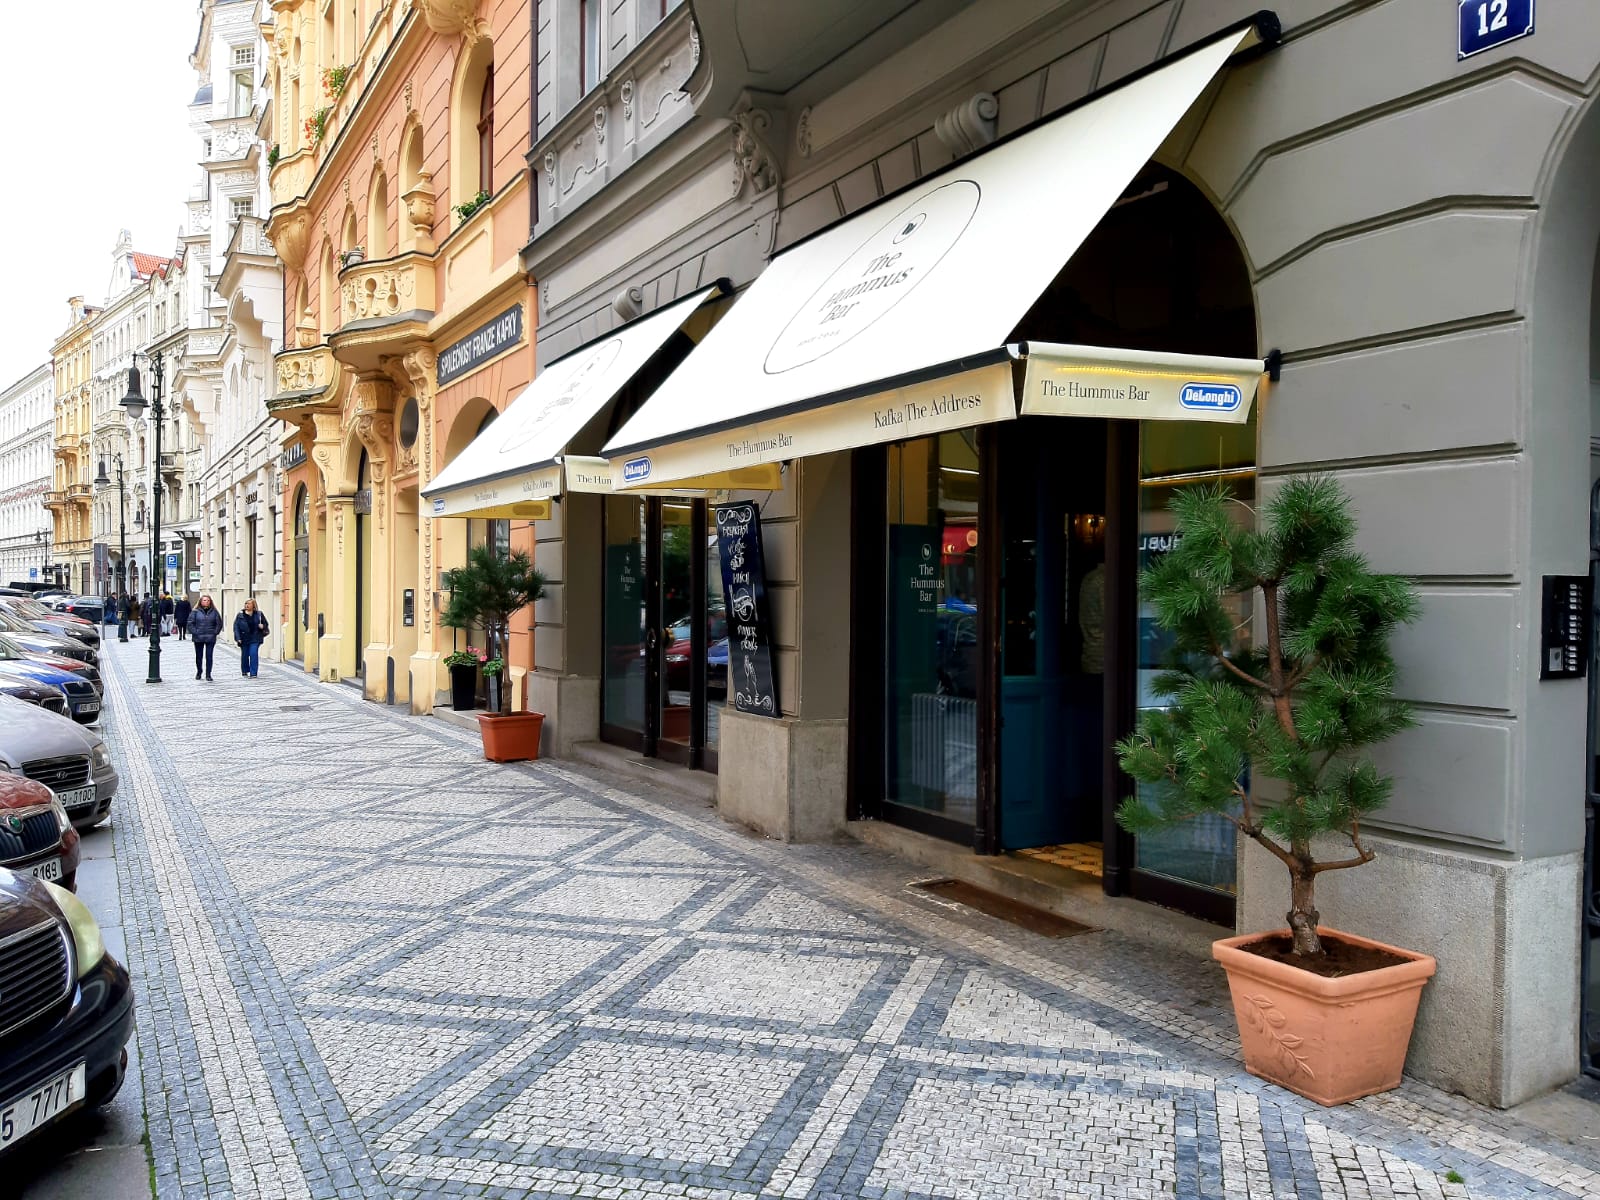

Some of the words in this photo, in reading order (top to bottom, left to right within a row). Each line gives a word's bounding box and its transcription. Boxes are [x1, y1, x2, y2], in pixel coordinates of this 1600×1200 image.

[1478, 0, 1508, 36] 12
[861, 251, 902, 278] The
[818, 266, 914, 312] Hummus
[818, 301, 860, 325] Bar
[441, 343, 472, 377] SPOLEČNOST
[472, 324, 496, 359] FRANZE
[496, 310, 518, 345] KAFKY
[1041, 379, 1066, 397] The
[1068, 381, 1125, 400] Hummus
[1128, 384, 1150, 401] Bar
[1184, 388, 1235, 406] DeLonghi
[873, 407, 904, 429] Kafka
[904, 401, 927, 421] The
[929, 391, 982, 418] Address
[726, 443, 742, 458] The
[742, 437, 777, 456] Hummus
[777, 432, 793, 448] Bar
[576, 474, 592, 484] The
[918, 564, 934, 576] The
[910, 576, 945, 590] Hummus
[919, 589, 933, 603] Bar
